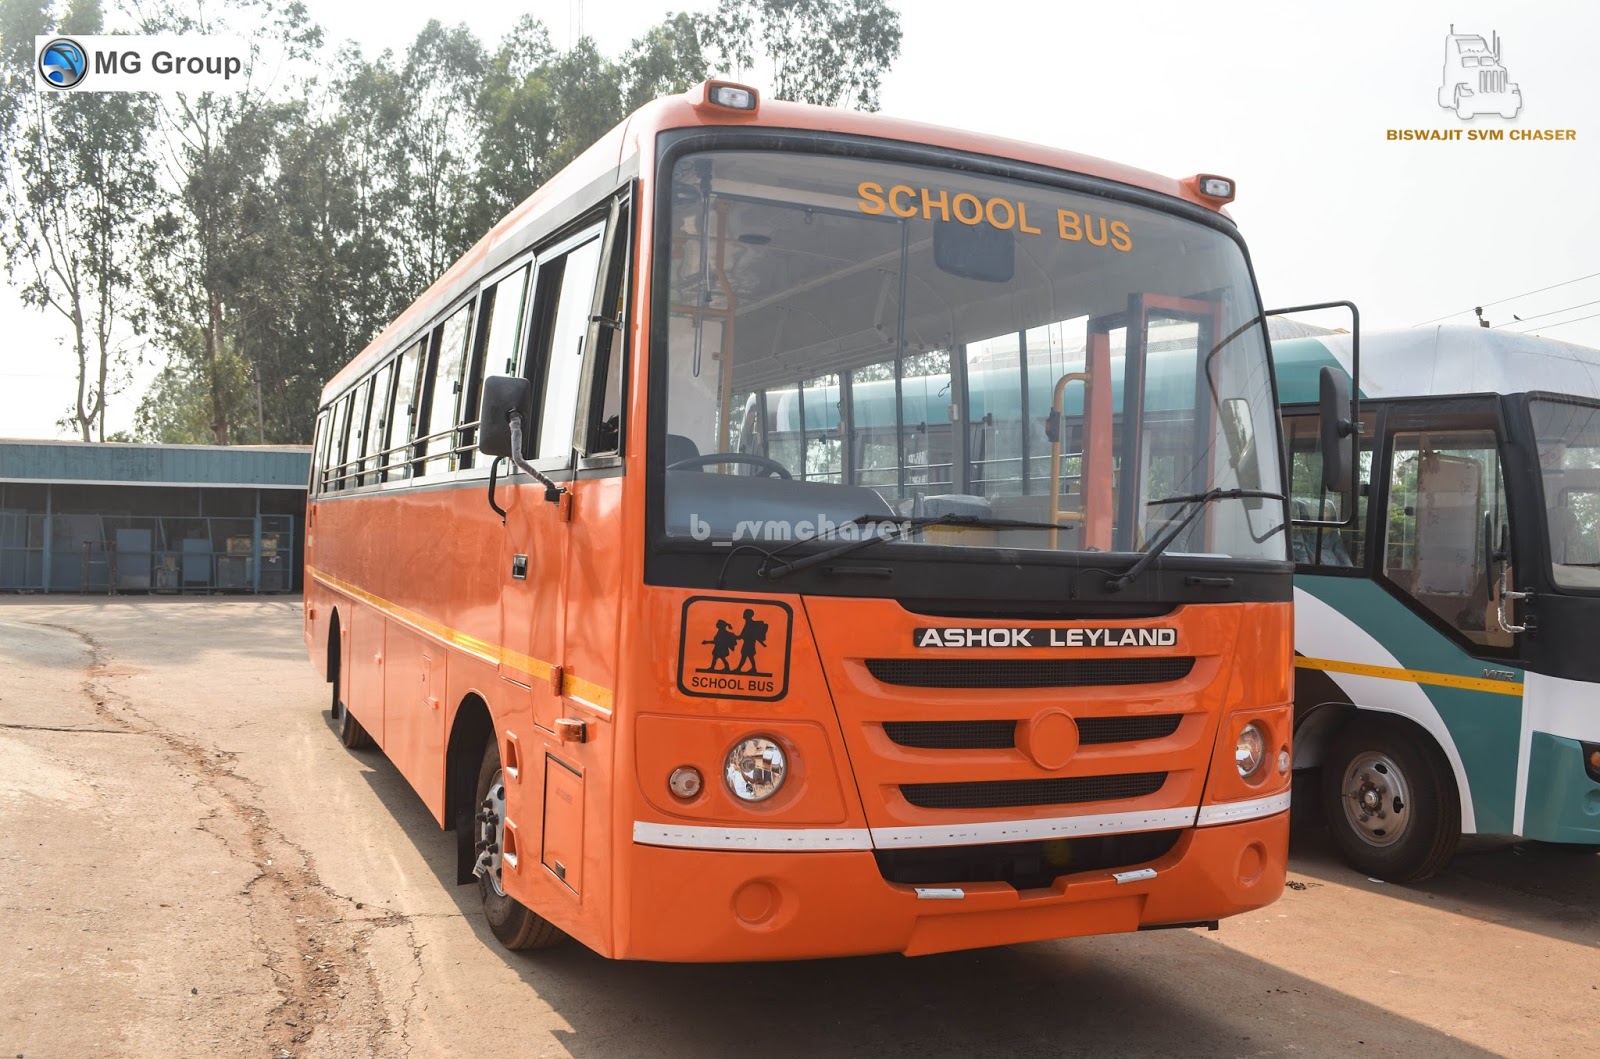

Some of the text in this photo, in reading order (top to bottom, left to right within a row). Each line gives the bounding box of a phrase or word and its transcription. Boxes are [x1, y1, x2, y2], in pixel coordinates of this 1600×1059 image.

[856, 180, 1133, 252] SCHOOL BUS
[918, 627, 1176, 647] ASHOK LEYLAND
[1482, 668, 1515, 681] MITR
[691, 676, 774, 692] SCHOOL BUS
